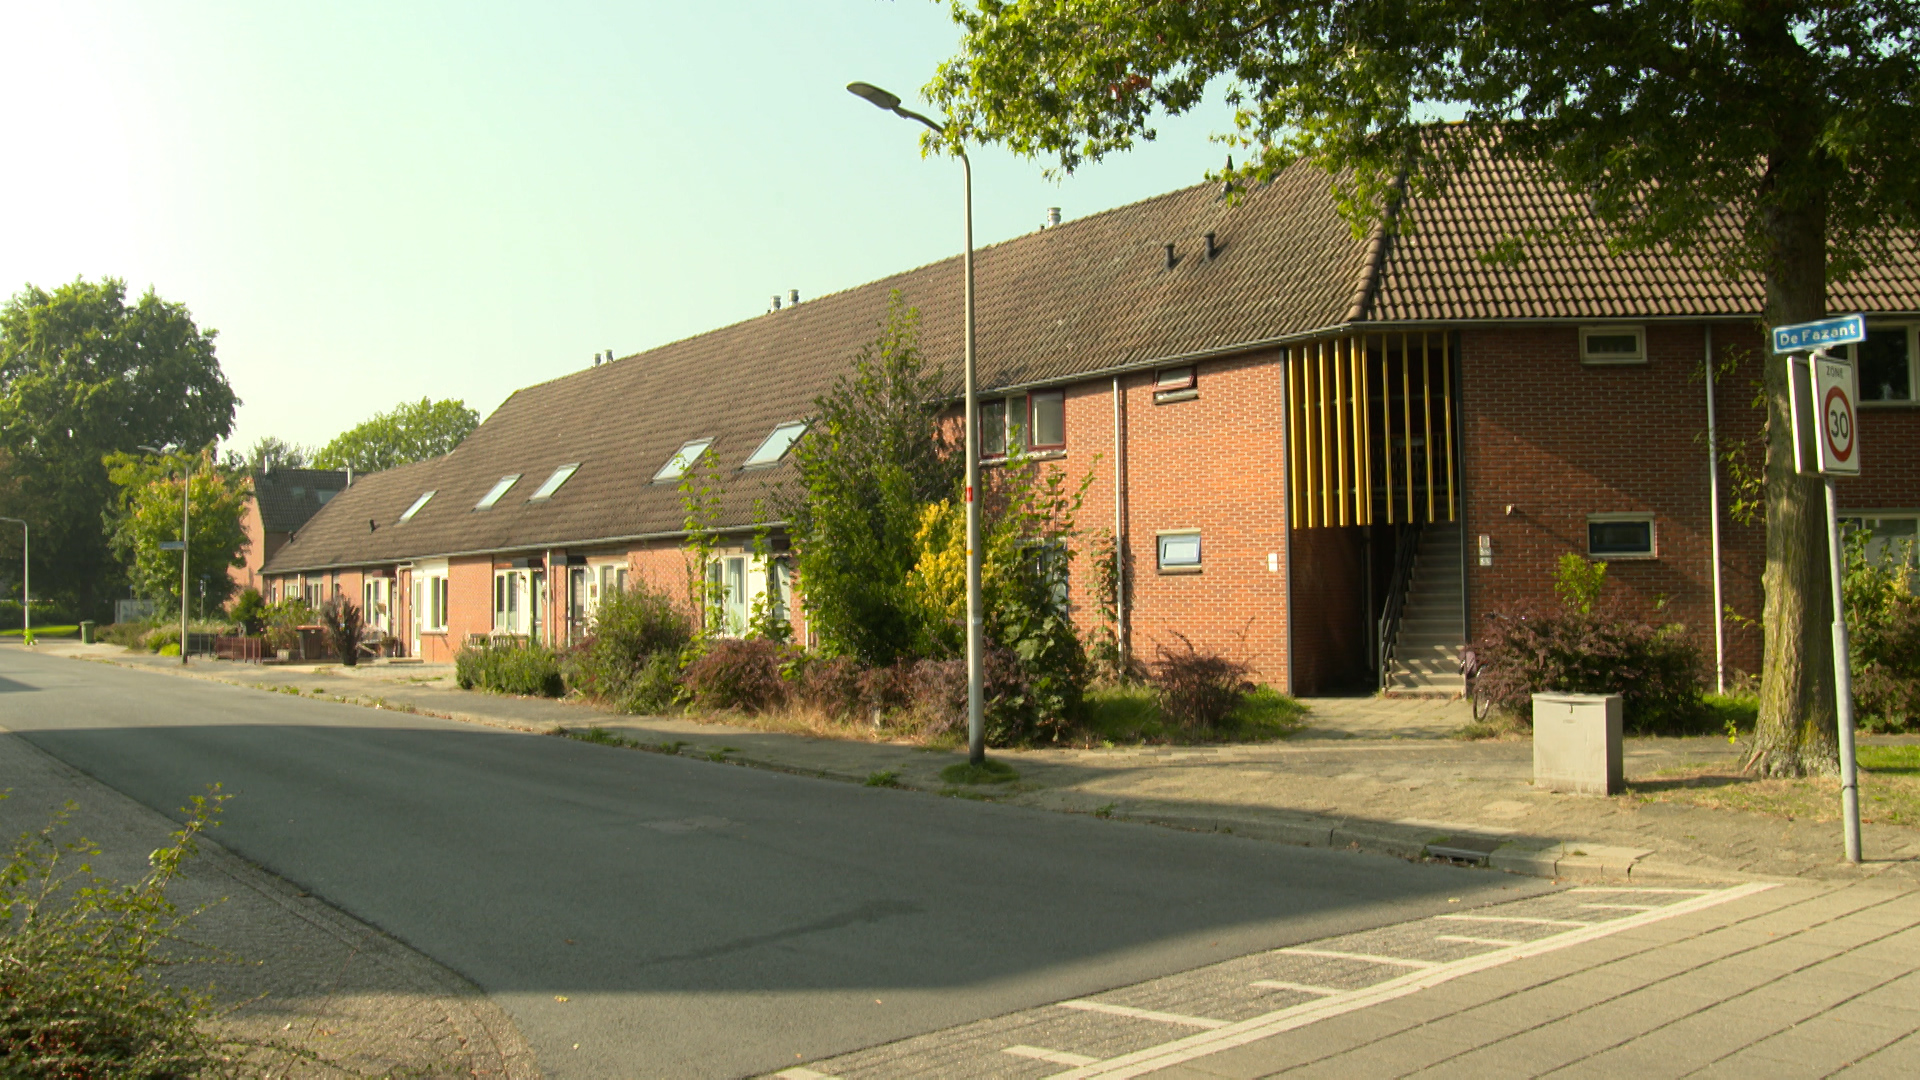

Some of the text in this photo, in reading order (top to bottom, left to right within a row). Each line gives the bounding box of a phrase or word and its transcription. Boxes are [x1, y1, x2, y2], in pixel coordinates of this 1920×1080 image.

[1780, 323, 1856, 346] De Fazant
[1826, 365, 1844, 379] ZONE
[1830, 409, 1849, 439] 30
